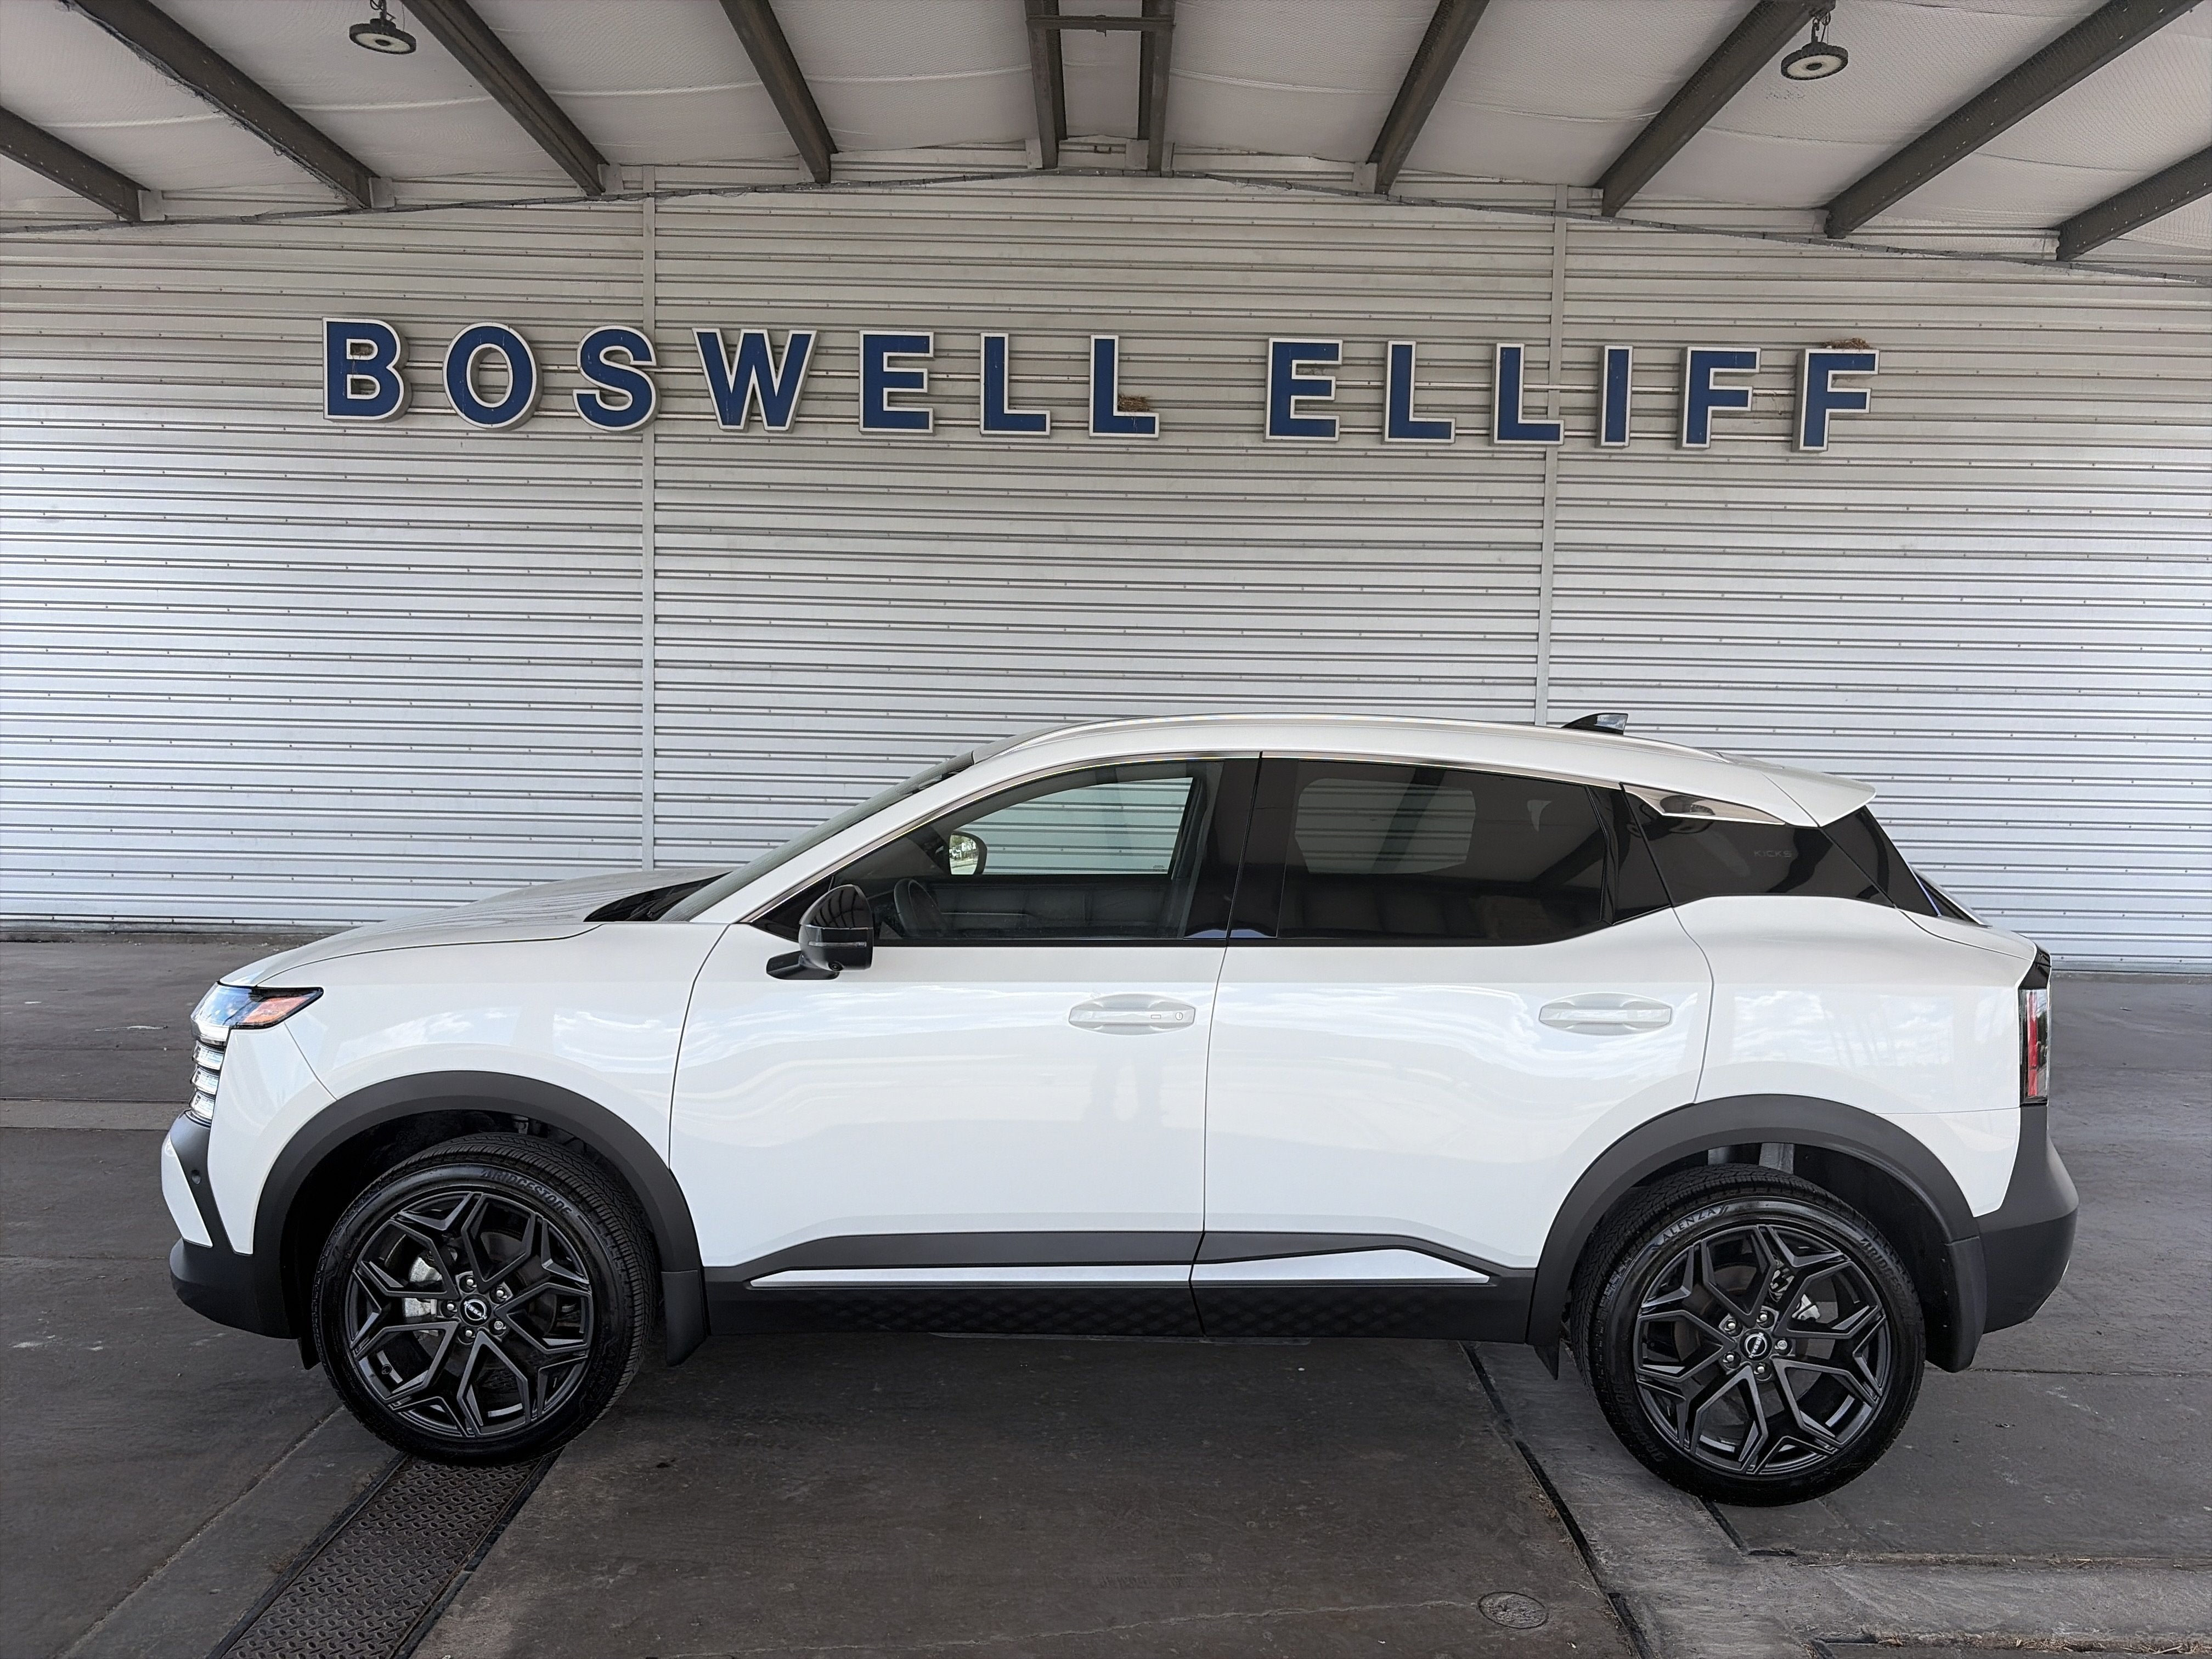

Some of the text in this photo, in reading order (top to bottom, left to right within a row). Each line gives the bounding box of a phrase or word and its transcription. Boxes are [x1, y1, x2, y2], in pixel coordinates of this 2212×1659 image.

[323, 317, 1880, 452] BOSWELL ELLIFF
[1661, 1206, 1717, 1242] ALENZA
[464, 1301, 487, 1319] NISSAN
[1748, 1332, 1764, 1358] NISSAN
